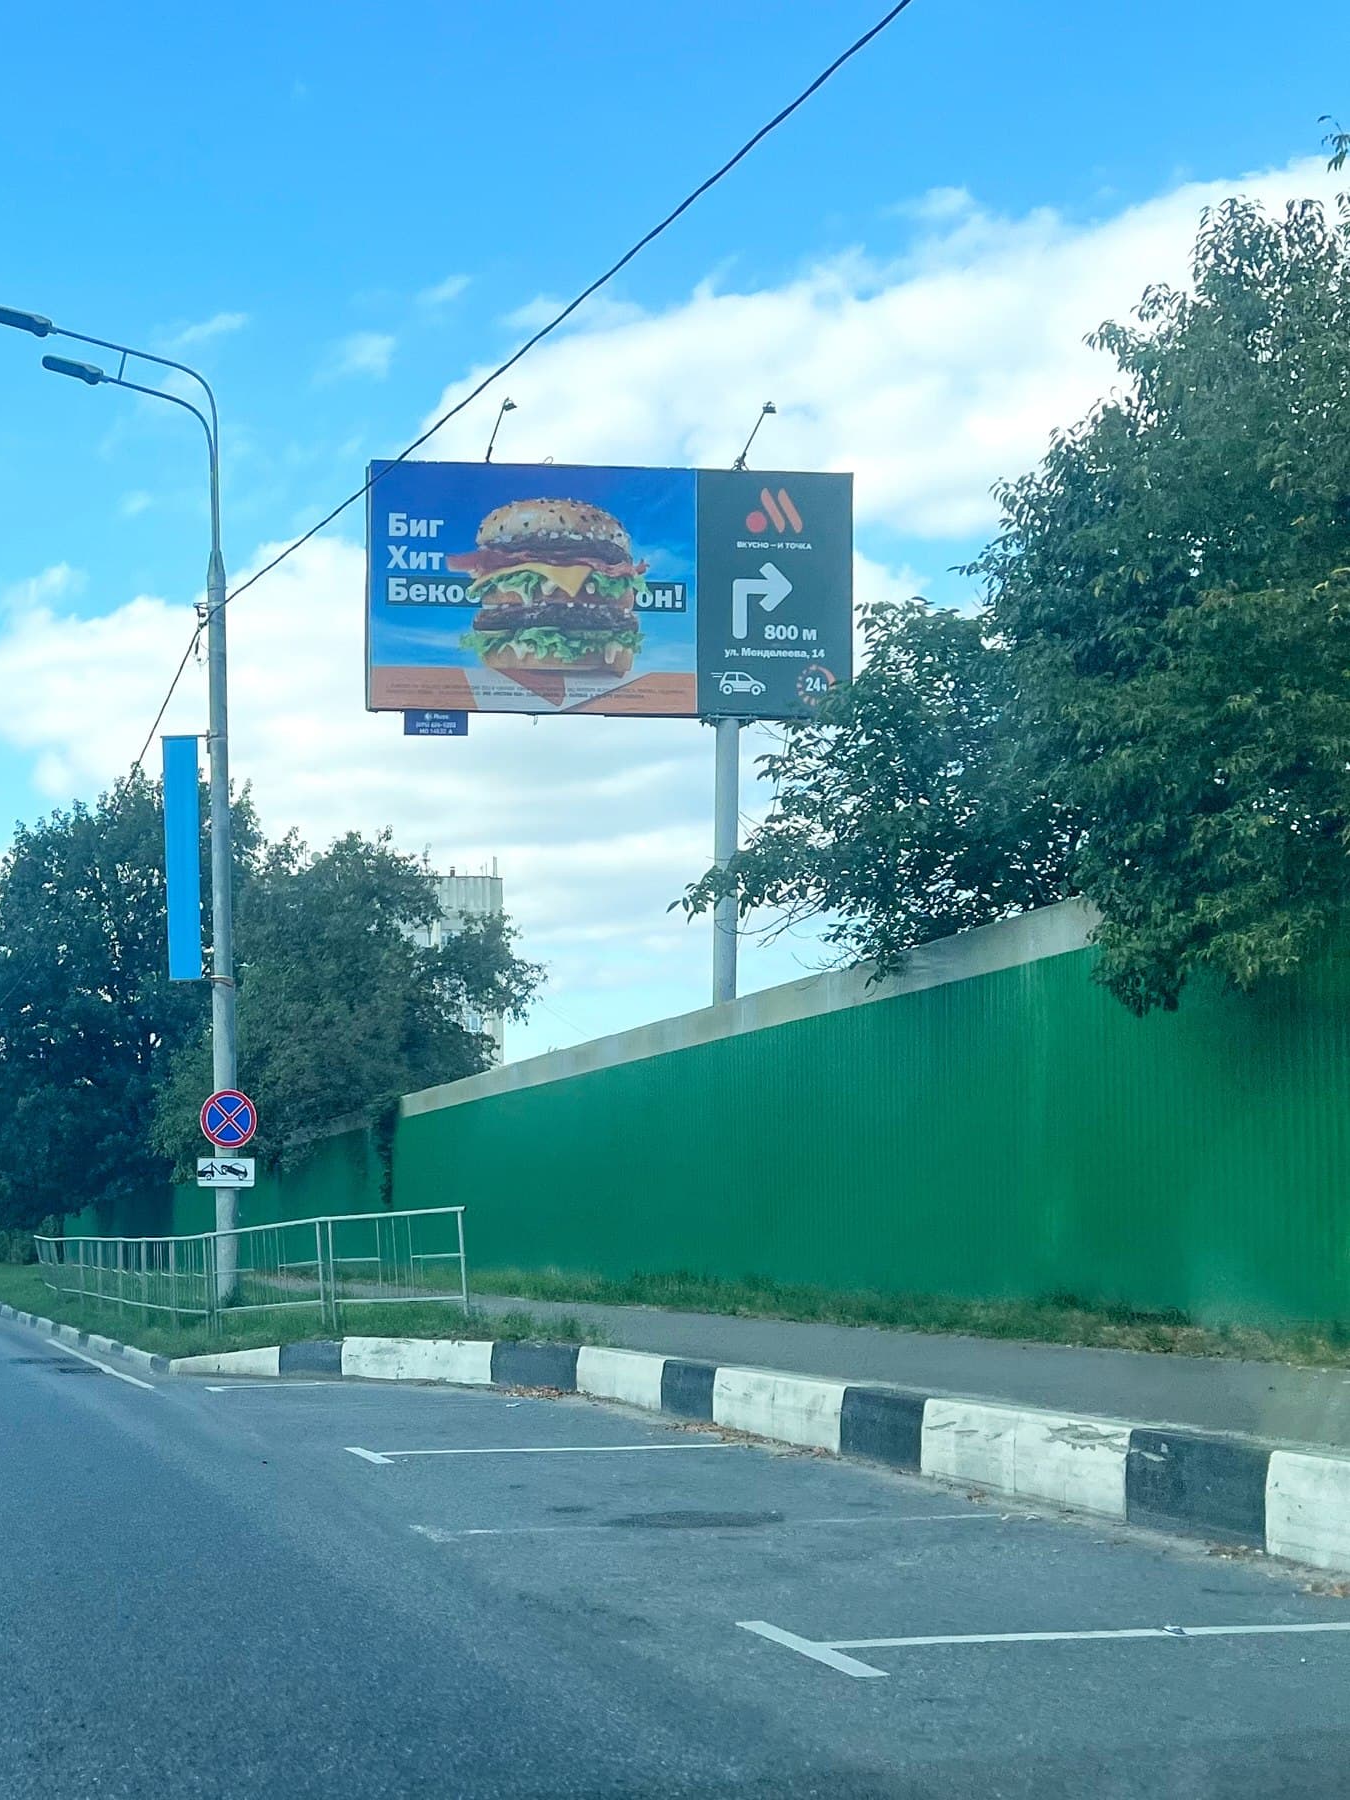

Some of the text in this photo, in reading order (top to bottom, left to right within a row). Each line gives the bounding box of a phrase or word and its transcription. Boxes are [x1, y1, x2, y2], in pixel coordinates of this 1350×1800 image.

[388, 512, 444, 538] Биг
[786, 542, 812, 550] ТОЧКА
[386, 545, 444, 570] Хит
[764, 624, 817, 640] 800 м
[724, 648, 739, 658] ул.
[812, 649, 825, 658] 14
